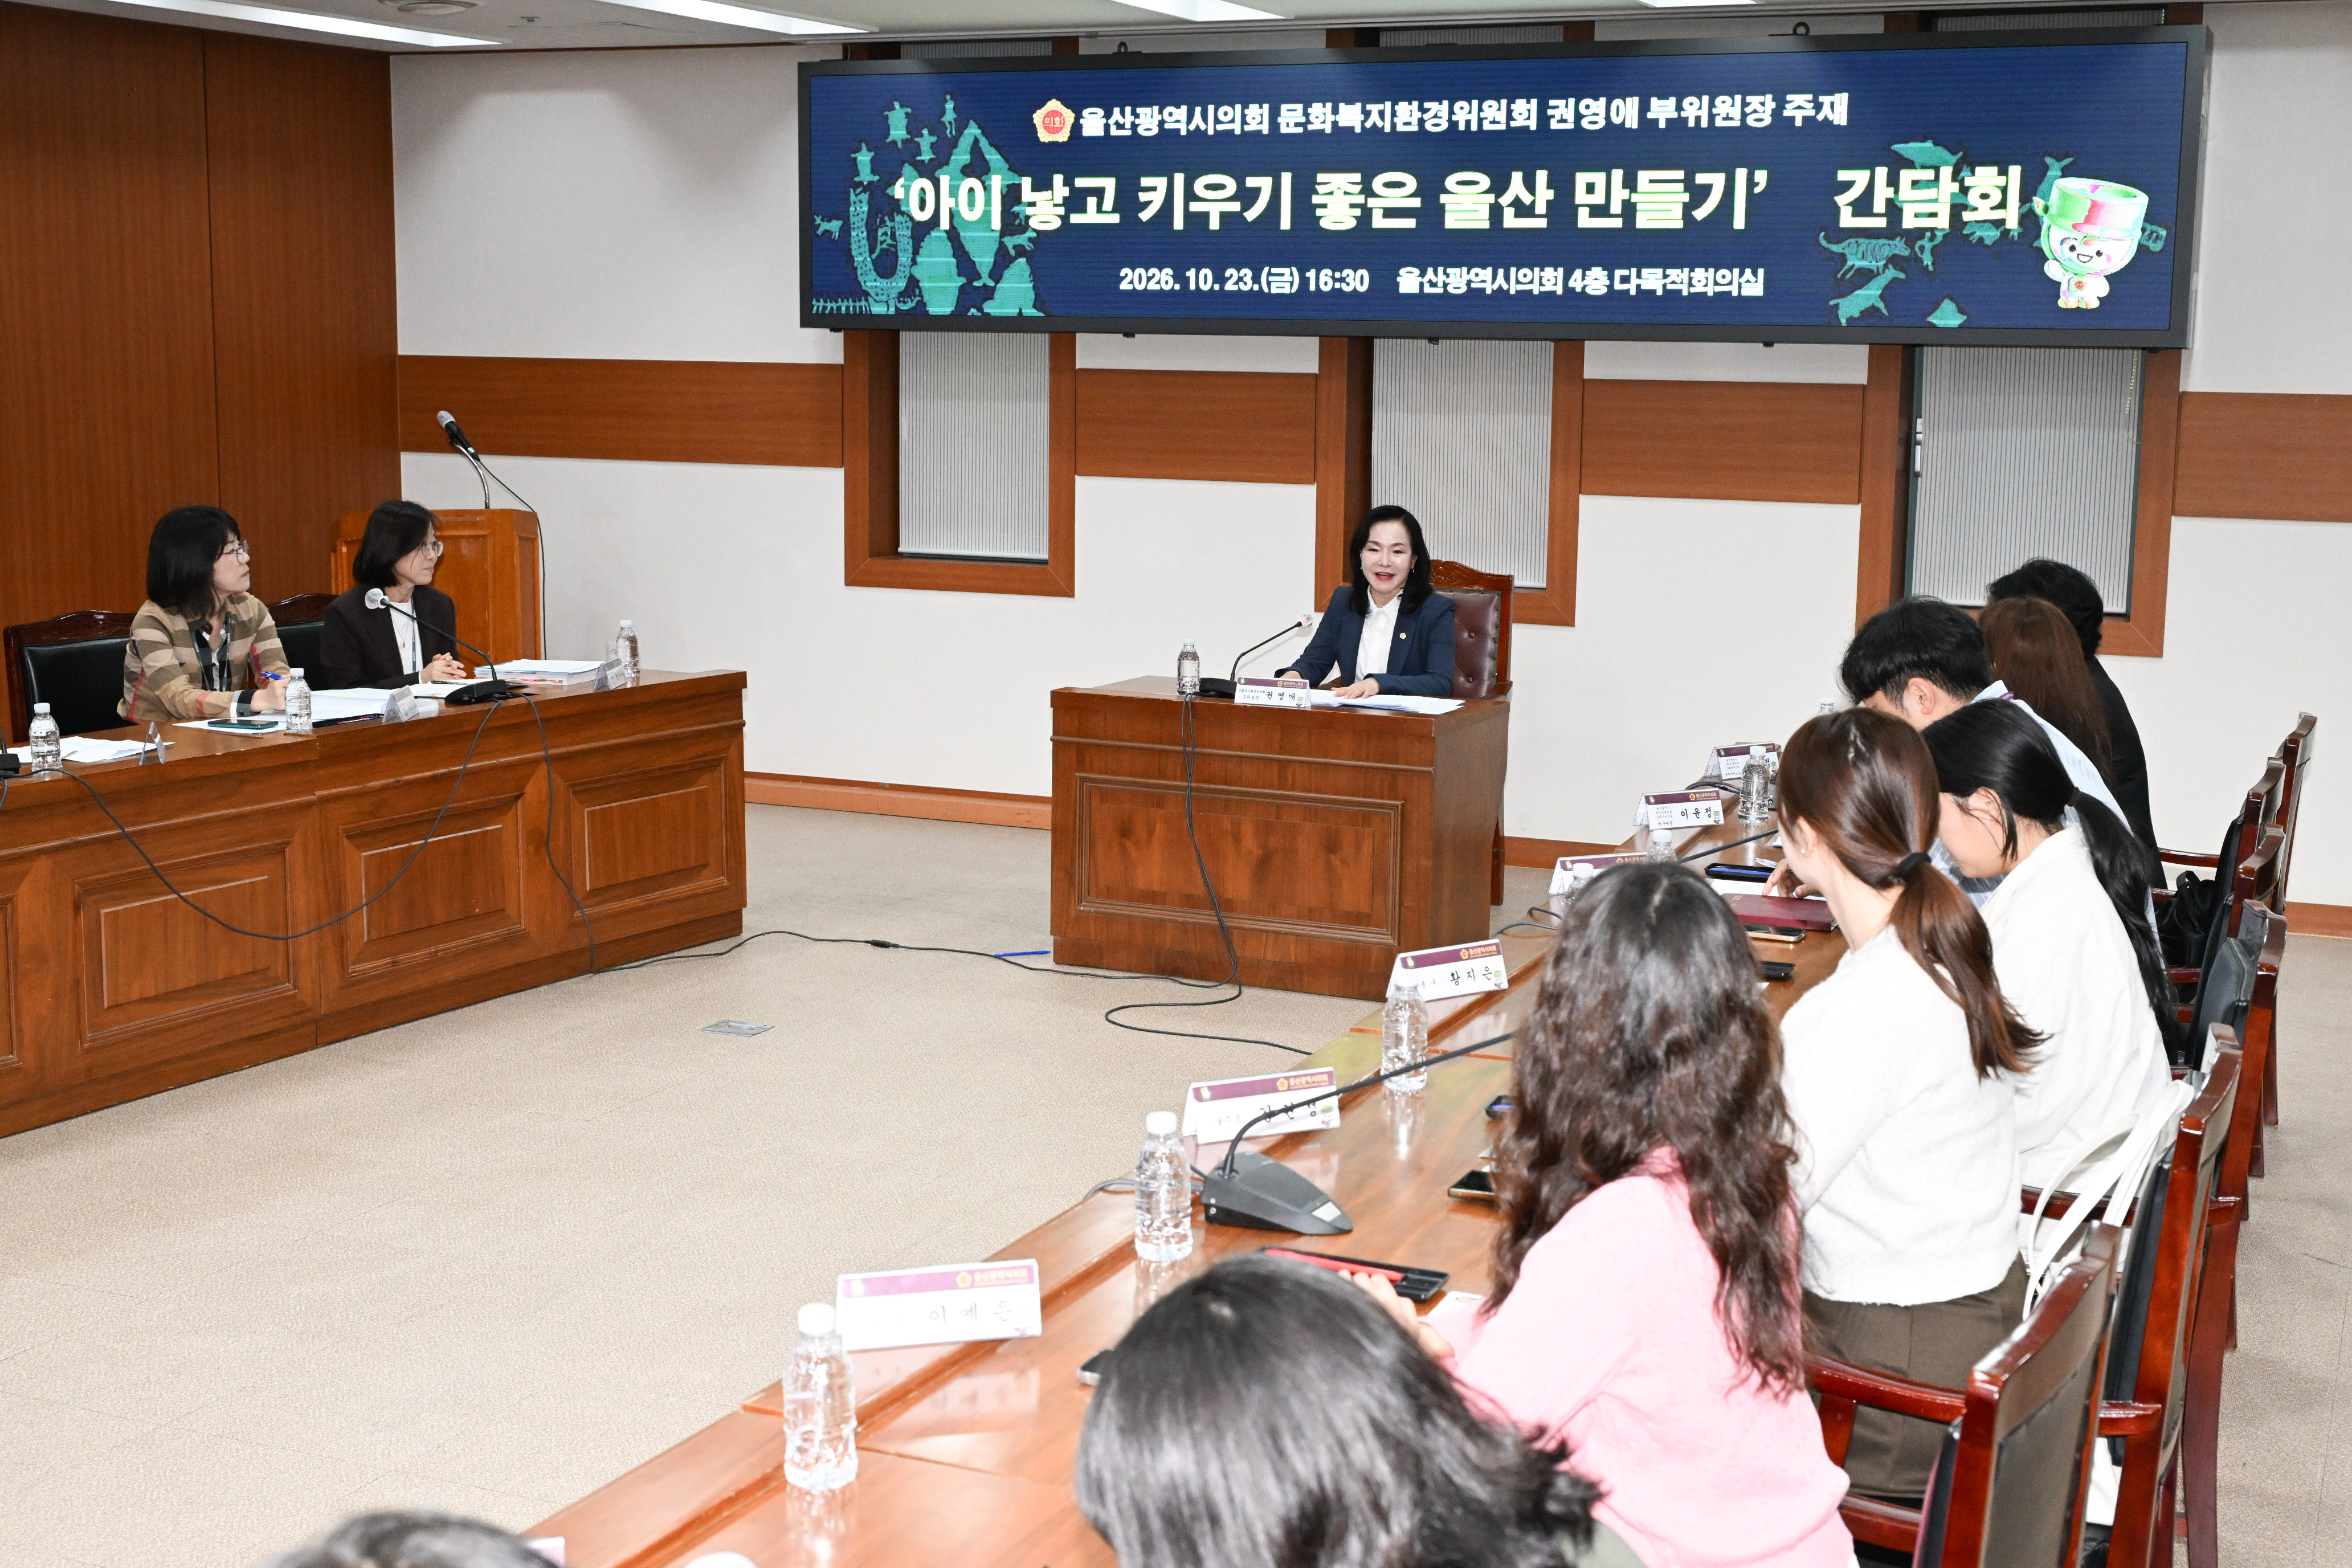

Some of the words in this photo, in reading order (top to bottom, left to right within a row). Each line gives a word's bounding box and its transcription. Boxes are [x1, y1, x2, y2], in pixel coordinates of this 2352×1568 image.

[1080, 104, 1269, 136] 울산광역시의회
[1277, 98, 1538, 133] 문화복지환경위원회
[1547, 96, 1639, 130] 권영애
[1647, 94, 1776, 129] 부위원장
[1783, 92, 1849, 126] 주재
[1021, 174, 1120, 231] 낳고
[1138, 173, 1292, 230] 키우기
[1312, 172, 1422, 230] 좋은
[1440, 169, 1554, 229] 울산
[1834, 165, 2022, 229] 간담회
[1119, 268, 1180, 291] 2026.
[1186, 268, 1219, 291] 10.
[1224, 267, 1300, 294] 23.(금)
[1305, 268, 1370, 292] 16:30
[1396, 267, 1563, 295] 울산광역시의회
[1568, 267, 1610, 295] 4층
[1614, 267, 1765, 296] 다목적회의실
[1266, 691, 1296, 701] 권영애
[1450, 966, 1492, 986] 황지은
